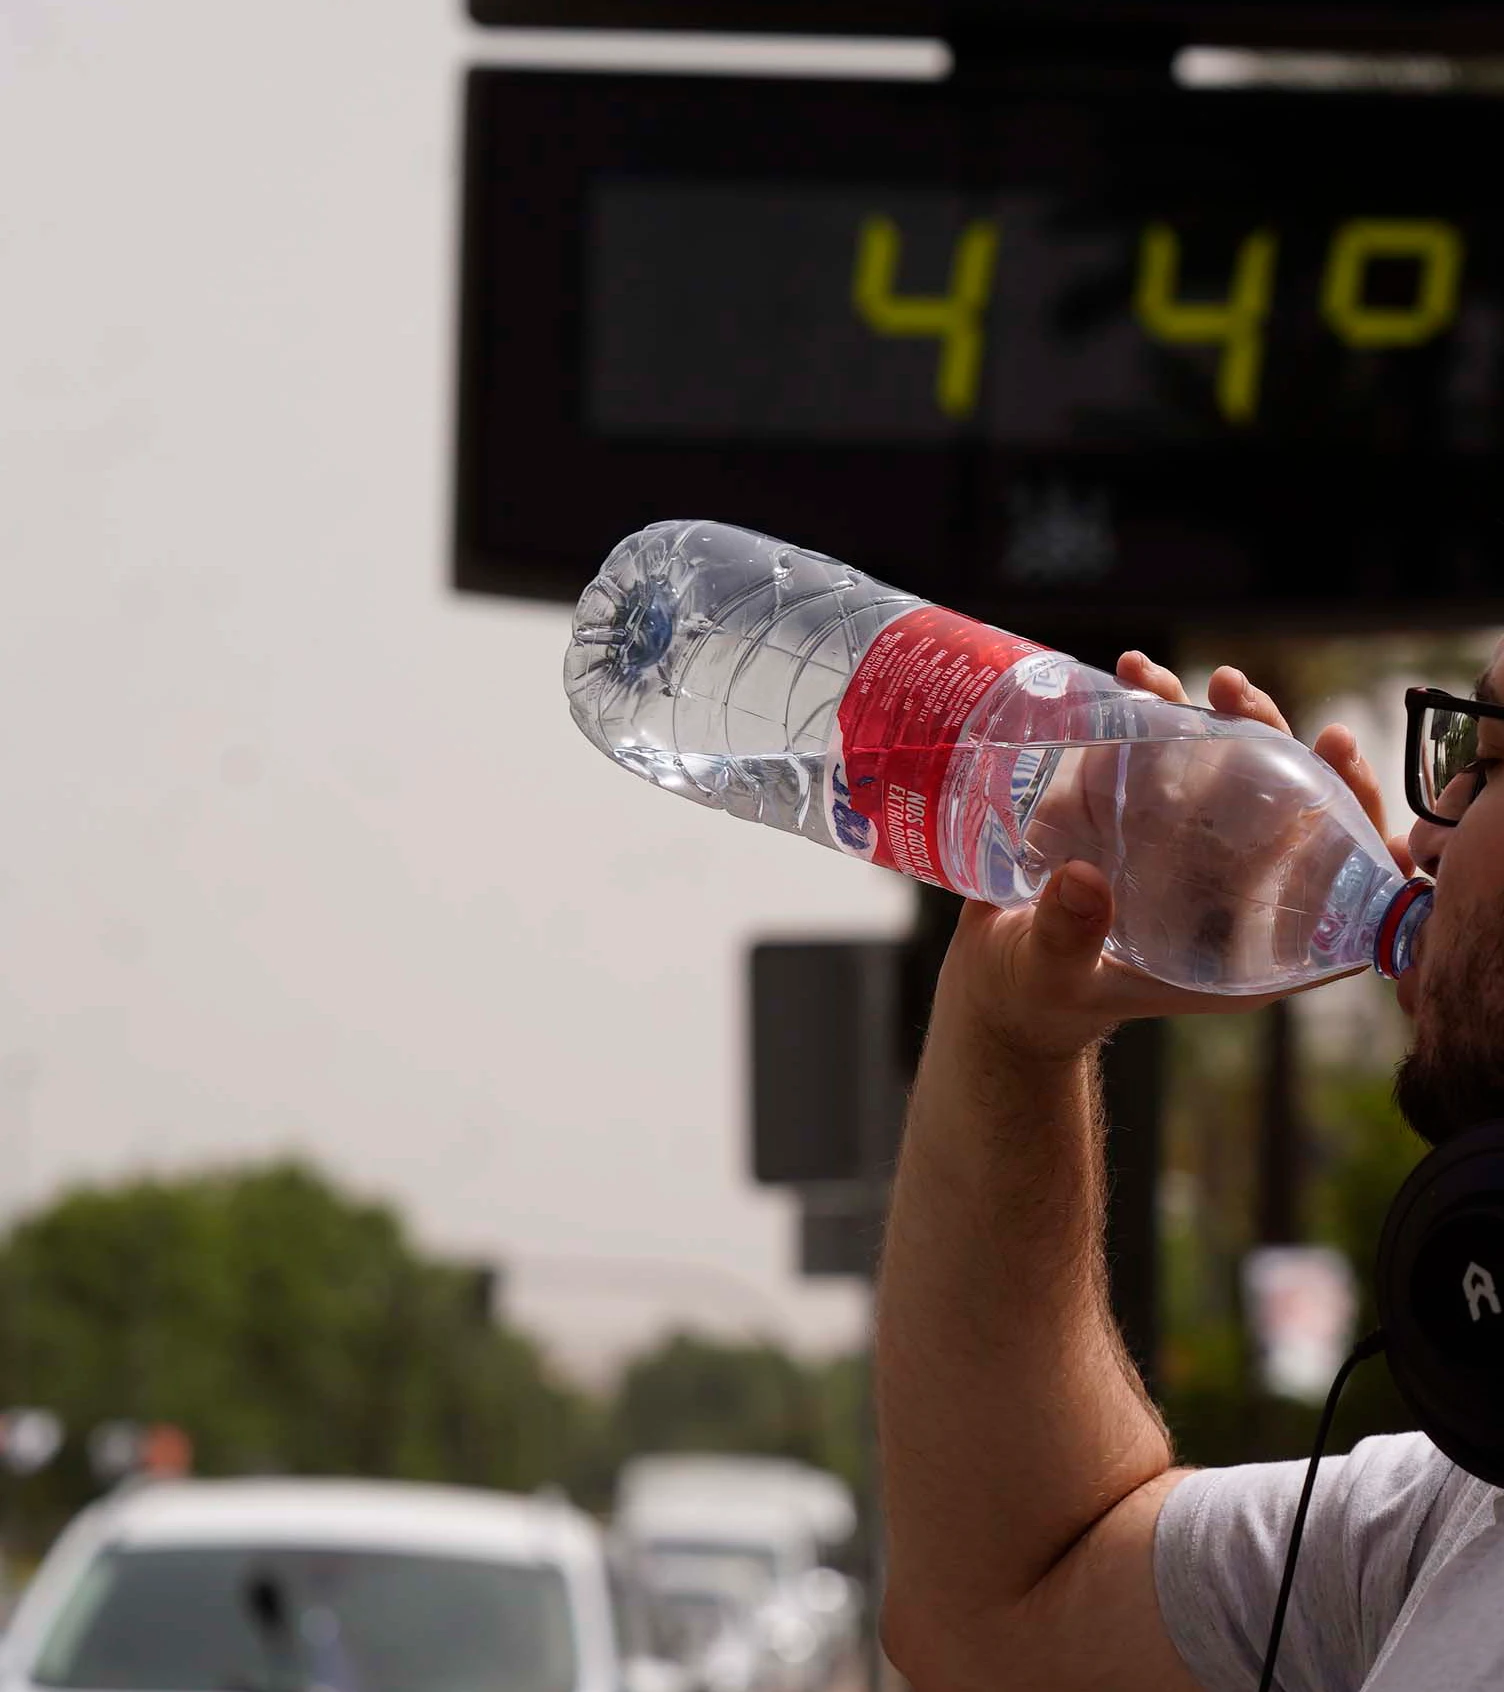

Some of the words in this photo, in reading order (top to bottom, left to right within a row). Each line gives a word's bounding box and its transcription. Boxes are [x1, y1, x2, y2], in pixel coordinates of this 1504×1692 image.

[881, 631, 904, 654] NUESTRAS
[856, 645, 882, 679] RECICLABLES
[865, 654, 886, 680] BOTELLAS
[914, 649, 948, 686] CONDUCTIVIDAD
[950, 653, 969, 668] CALCIO
[926, 667, 943, 682] SODIO
[938, 664, 970, 701] BICARBONATOS
[983, 670, 998, 681] AGUA
[859, 681, 870, 694] SON
[923, 679, 946, 708] MAGNESIO
[966, 681, 987, 702] MINERAL
[902, 697, 914, 711] 200
[951, 703, 970, 727] NATURAL
[905, 790, 928, 827] NOS
[887, 783, 918, 877] EXTRAORDINAR
[905, 828, 934, 871] GUSTA
